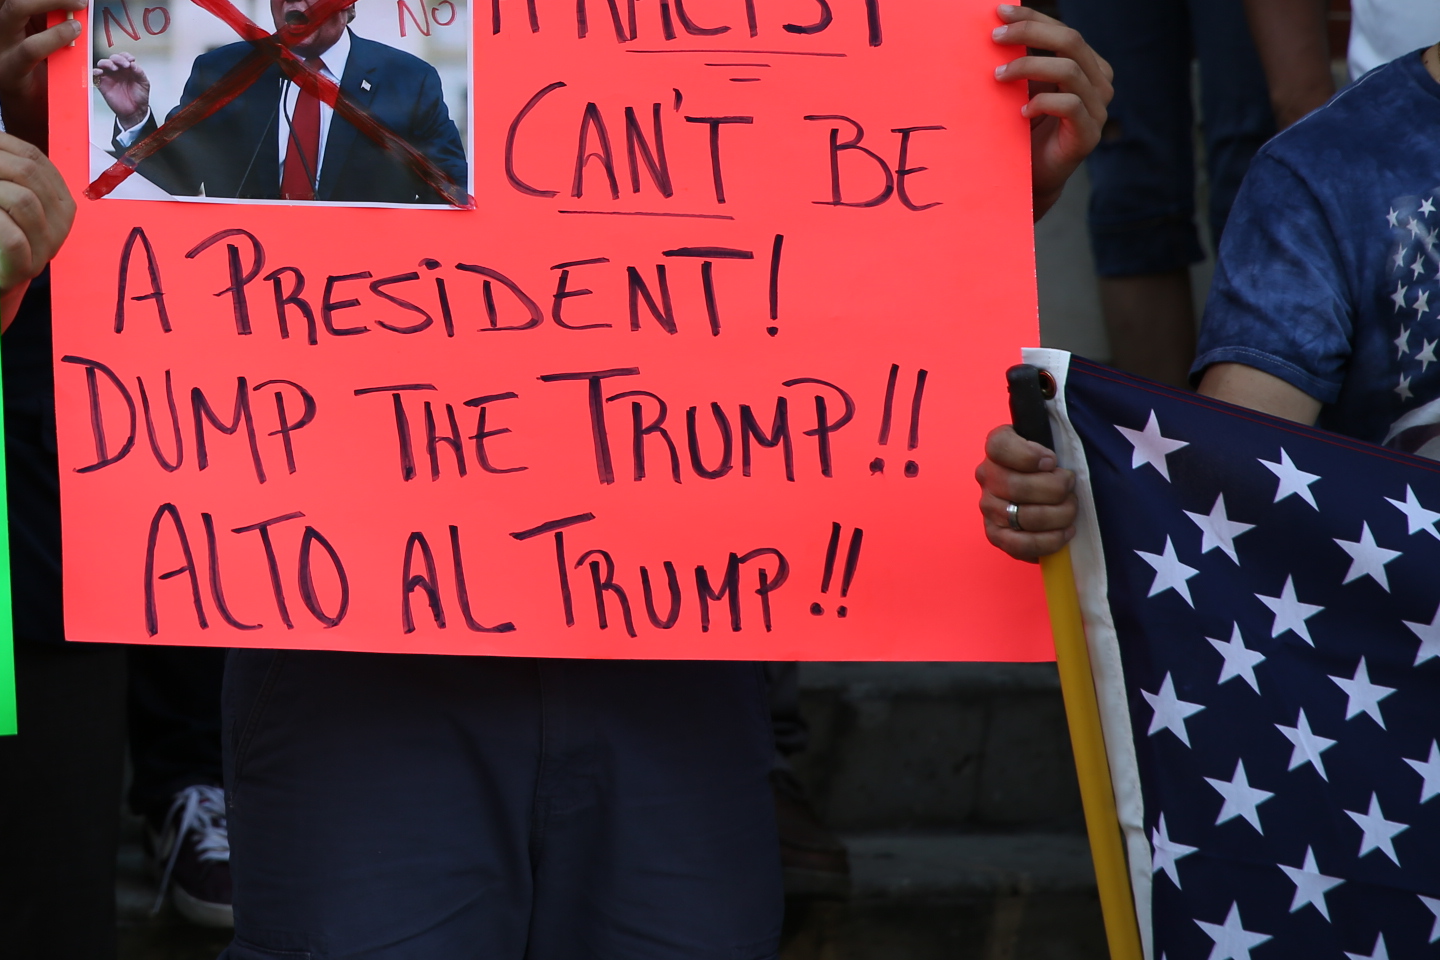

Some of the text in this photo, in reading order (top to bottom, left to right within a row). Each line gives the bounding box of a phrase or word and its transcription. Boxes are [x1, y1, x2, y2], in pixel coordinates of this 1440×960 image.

[503, 80, 948, 212] CAN'T BE
[113, 225, 173, 335] A
[60, 354, 318, 486] DUMP
[353, 383, 530, 483] THE
[143, 501, 350, 638] ALTO
[401, 523, 518, 635] AL
